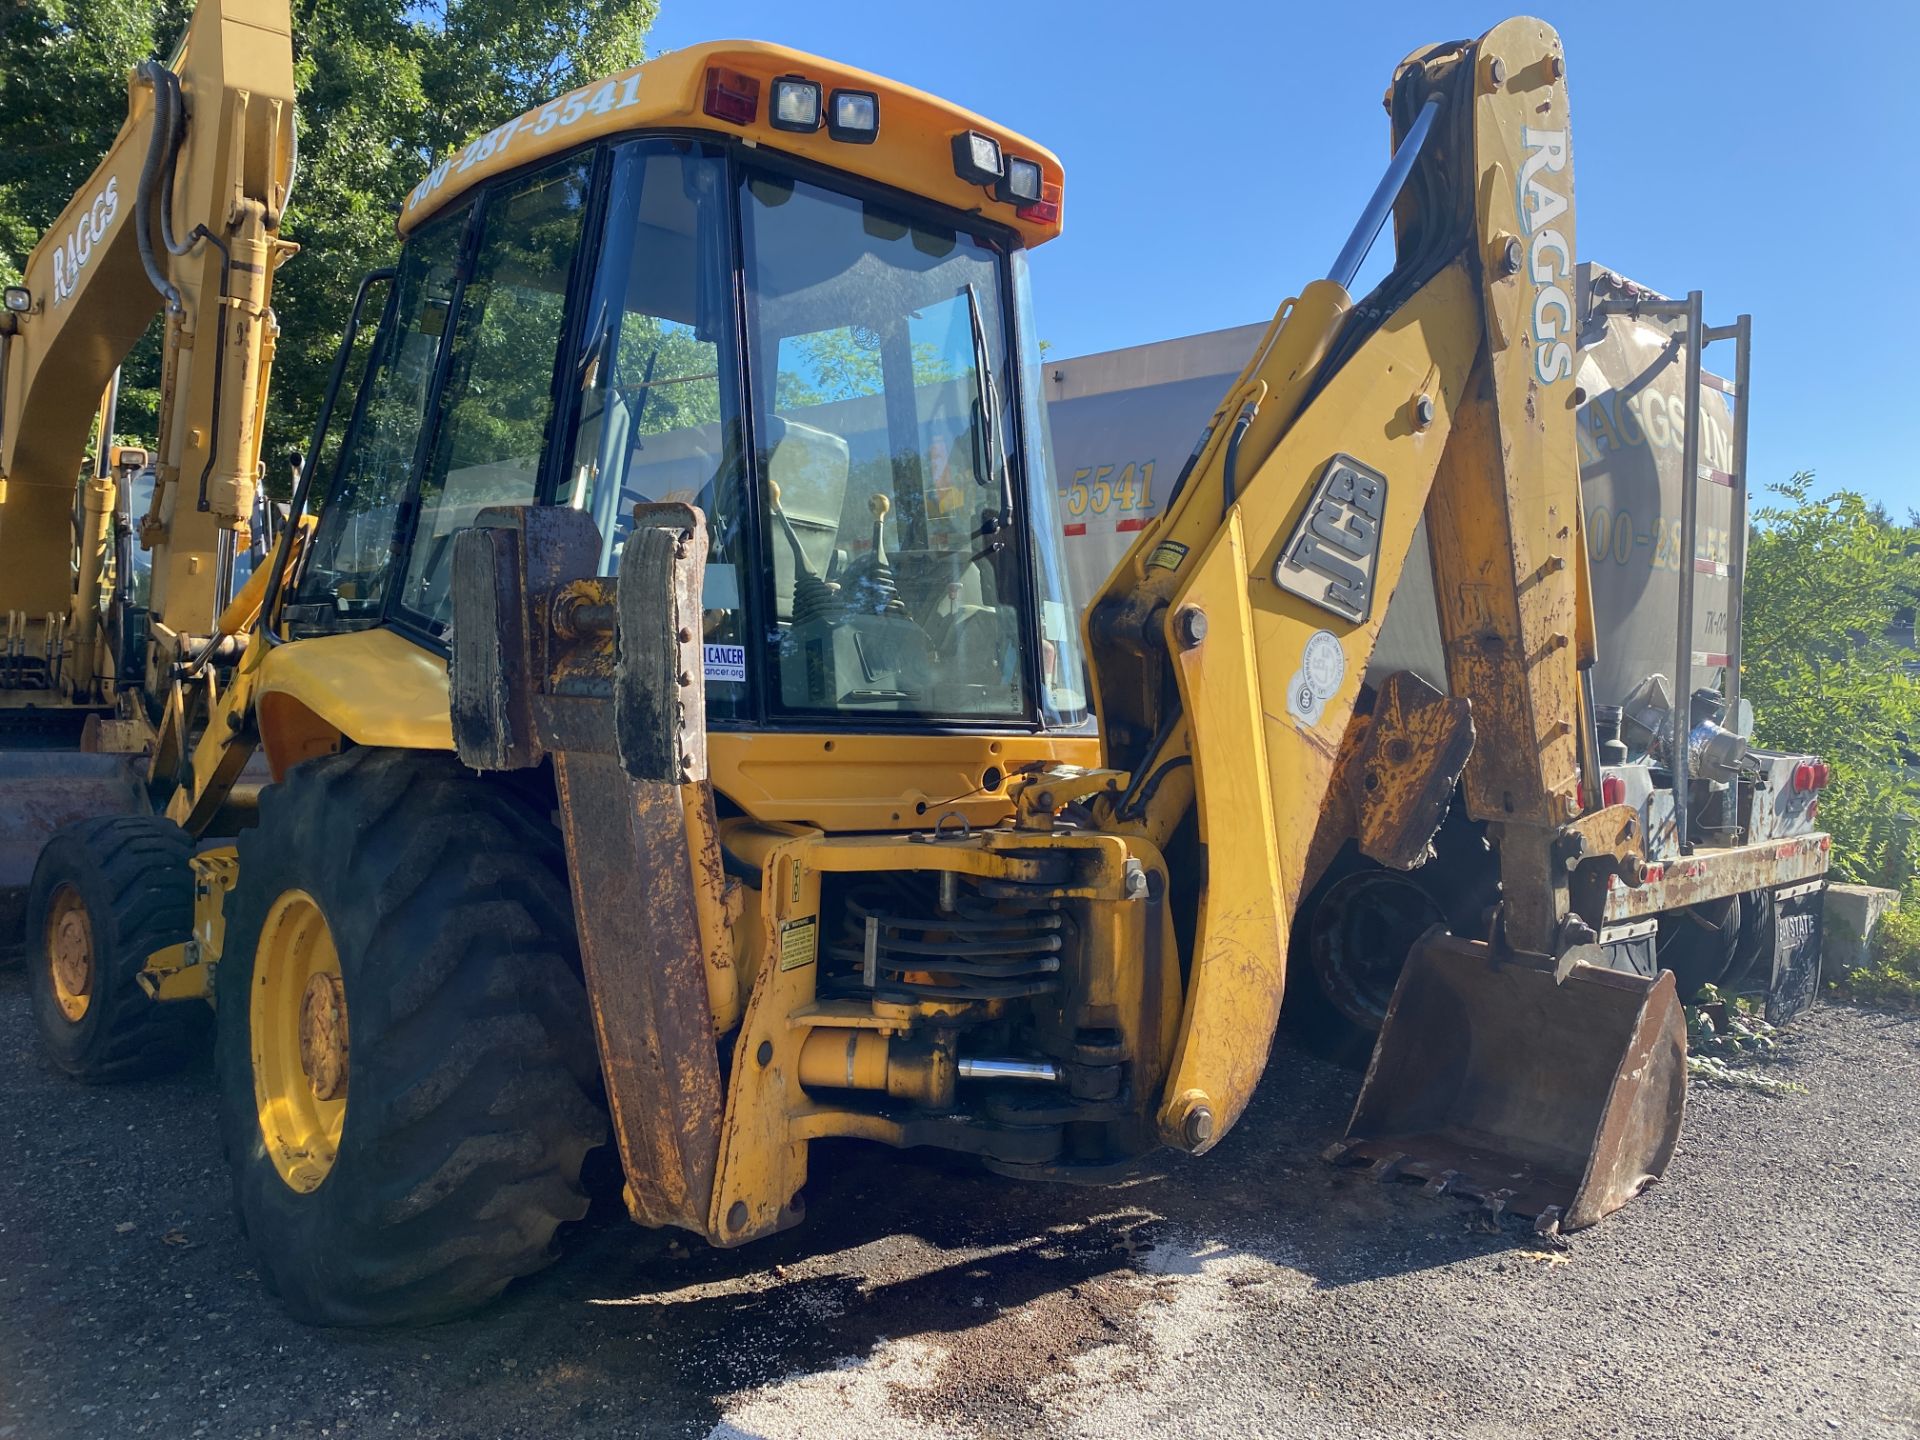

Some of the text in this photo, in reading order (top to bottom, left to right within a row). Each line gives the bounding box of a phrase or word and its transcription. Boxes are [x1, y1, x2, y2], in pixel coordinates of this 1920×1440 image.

[408, 73, 643, 210] 800-287-5541
[53, 175, 118, 306] RAGGS
[1517, 126, 1573, 385] RAGGS
[1700, 406, 1733, 473] IN
[1291, 466, 1379, 613] JCB
[1588, 505, 1729, 578] 00-28-55
[704, 668, 744, 678] ancer.org
[708, 647, 744, 664] CANCER
[1789, 914, 1815, 938] STATE
